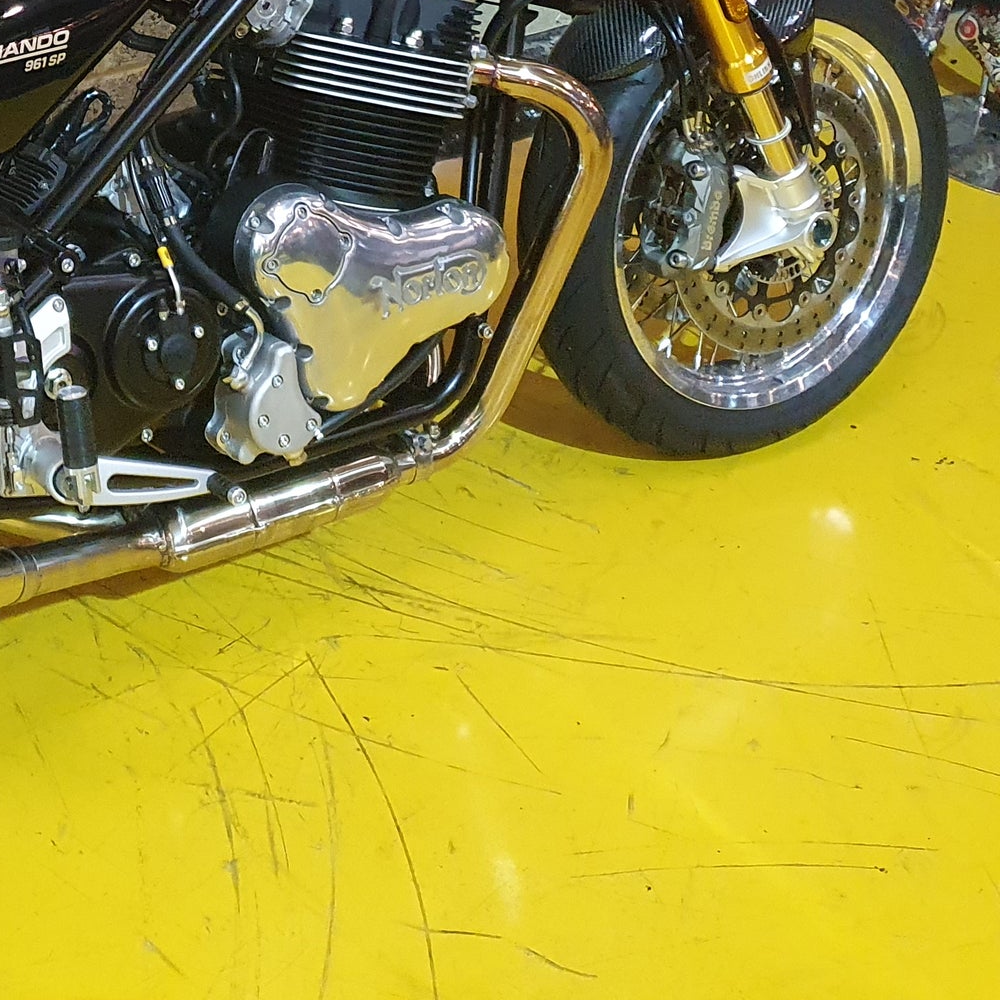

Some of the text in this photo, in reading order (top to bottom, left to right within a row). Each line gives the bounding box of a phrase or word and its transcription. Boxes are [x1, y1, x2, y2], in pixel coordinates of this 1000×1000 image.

[24, 52, 67, 73] 961 SP
[701, 191, 723, 251] brembo
[369, 249, 487, 320] Norton
